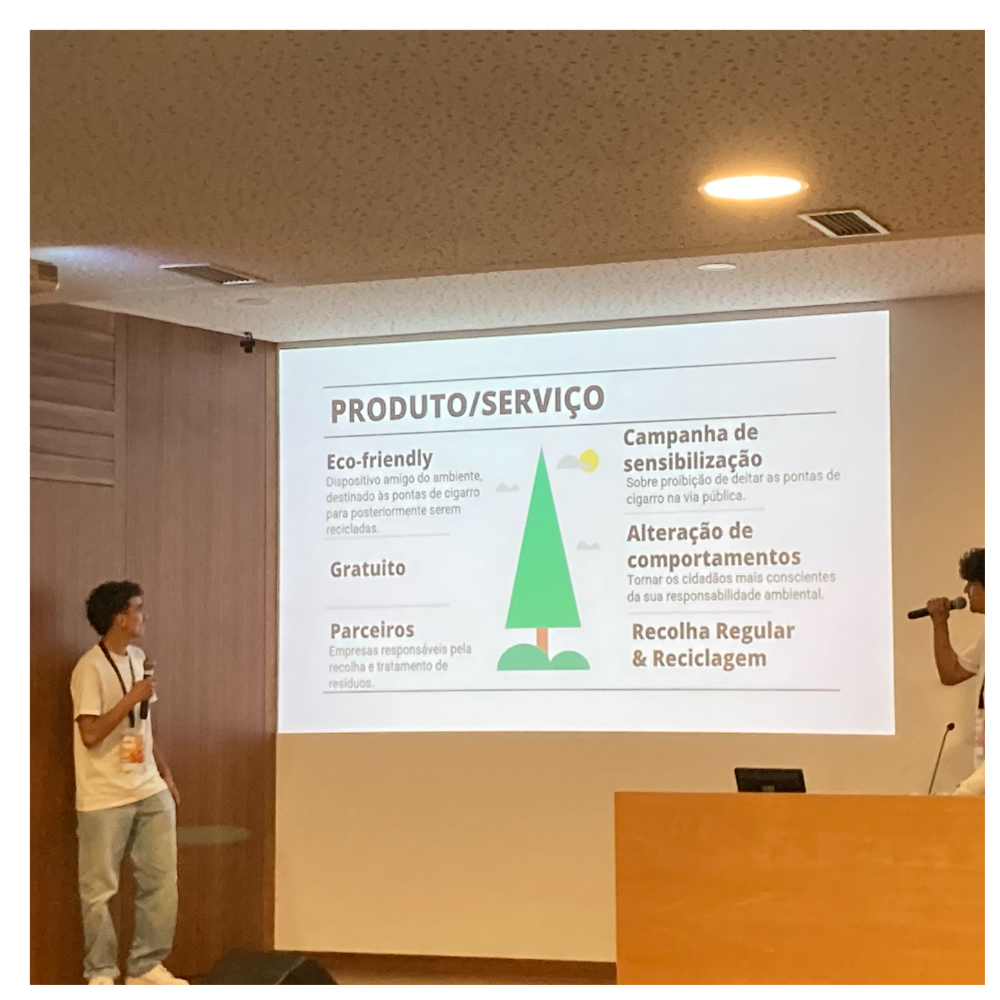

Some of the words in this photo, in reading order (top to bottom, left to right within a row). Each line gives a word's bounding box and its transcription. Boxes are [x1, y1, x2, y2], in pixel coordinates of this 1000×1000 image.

[331, 384, 605, 423] PRODUTO/SERVIÇO
[624, 424, 728, 449] Campanha
[734, 423, 759, 441] de
[326, 449, 433, 470] Eco-friendly
[624, 449, 763, 473] sensibilização
[326, 475, 381, 488] Dispositivo
[384, 474, 415, 487] amigo
[417, 472, 431, 484] do
[433, 470, 483, 483] ambiente,
[626, 475, 658, 488] Sobre
[661, 473, 712, 488] proibição
[715, 472, 729, 485] de
[731, 471, 764, 484] deitar
[766, 473, 780, 484] as
[783, 470, 823, 485] pontas
[826, 469, 841, 481] de
[326, 490, 374, 503] destinado
[377, 490, 390, 502] às
[392, 488, 428, 503] pontas
[430, 487, 443, 500] de
[444, 486, 480, 502] cigarro
[626, 493, 664, 506] cigarro
[667, 493, 681, 504] na
[683, 491, 699, 503] via
[703, 490, 746, 505] pública.
[326, 509, 349, 521] para
[351, 504, 427, 520] posteriormente
[429, 504, 461, 515] serem
[326, 522, 380, 535] recicladas.
[627, 522, 723, 545] Alteração
[729, 521, 753, 540] de
[330, 559, 406, 578] Gratuito
[627, 549, 801, 572] comportamentos
[627, 573, 663, 586] Tornar
[665, 575, 680, 585] os
[682, 571, 733, 585] cidadãos
[736, 572, 764, 584] mais
[766, 571, 836, 584] conscientes
[627, 590, 641, 603] da
[644, 591, 664, 602] sua
[666, 588, 762, 604] responsabilidade
[764, 587, 825, 601] ambiental.
[330, 621, 415, 640] Parceiros
[632, 621, 710, 641] Recolha
[716, 620, 796, 644] Regular
[329, 645, 378, 659] Empresas
[381, 642, 448, 658] responsáveis
[450, 642, 472, 657] pela
[632, 649, 648, 667] &
[653, 648, 767, 672] Reciclagem
[329, 660, 366, 673] recolha
[377, 660, 433, 672] tratamento
[435, 659, 448, 671] de
[328, 677, 374, 690] resíduos.
